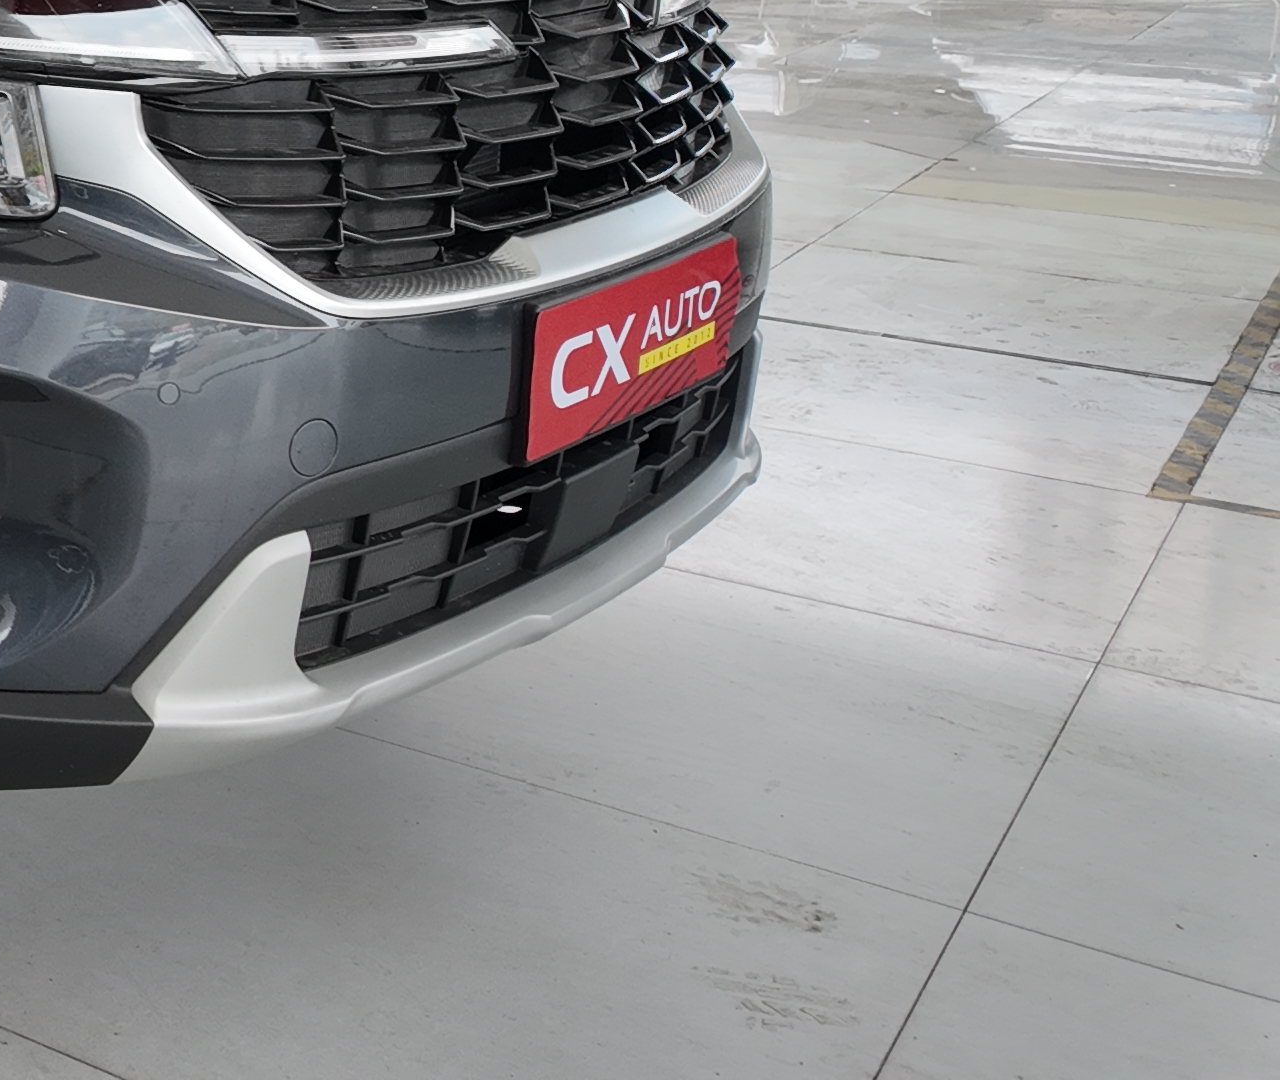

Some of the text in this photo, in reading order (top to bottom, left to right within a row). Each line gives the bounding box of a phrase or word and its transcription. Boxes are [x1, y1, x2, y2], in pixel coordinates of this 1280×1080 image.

[640, 280, 722, 350] AUTO
[644, 326, 715, 370] SINCE 2012
[550, 313, 636, 409] CX
